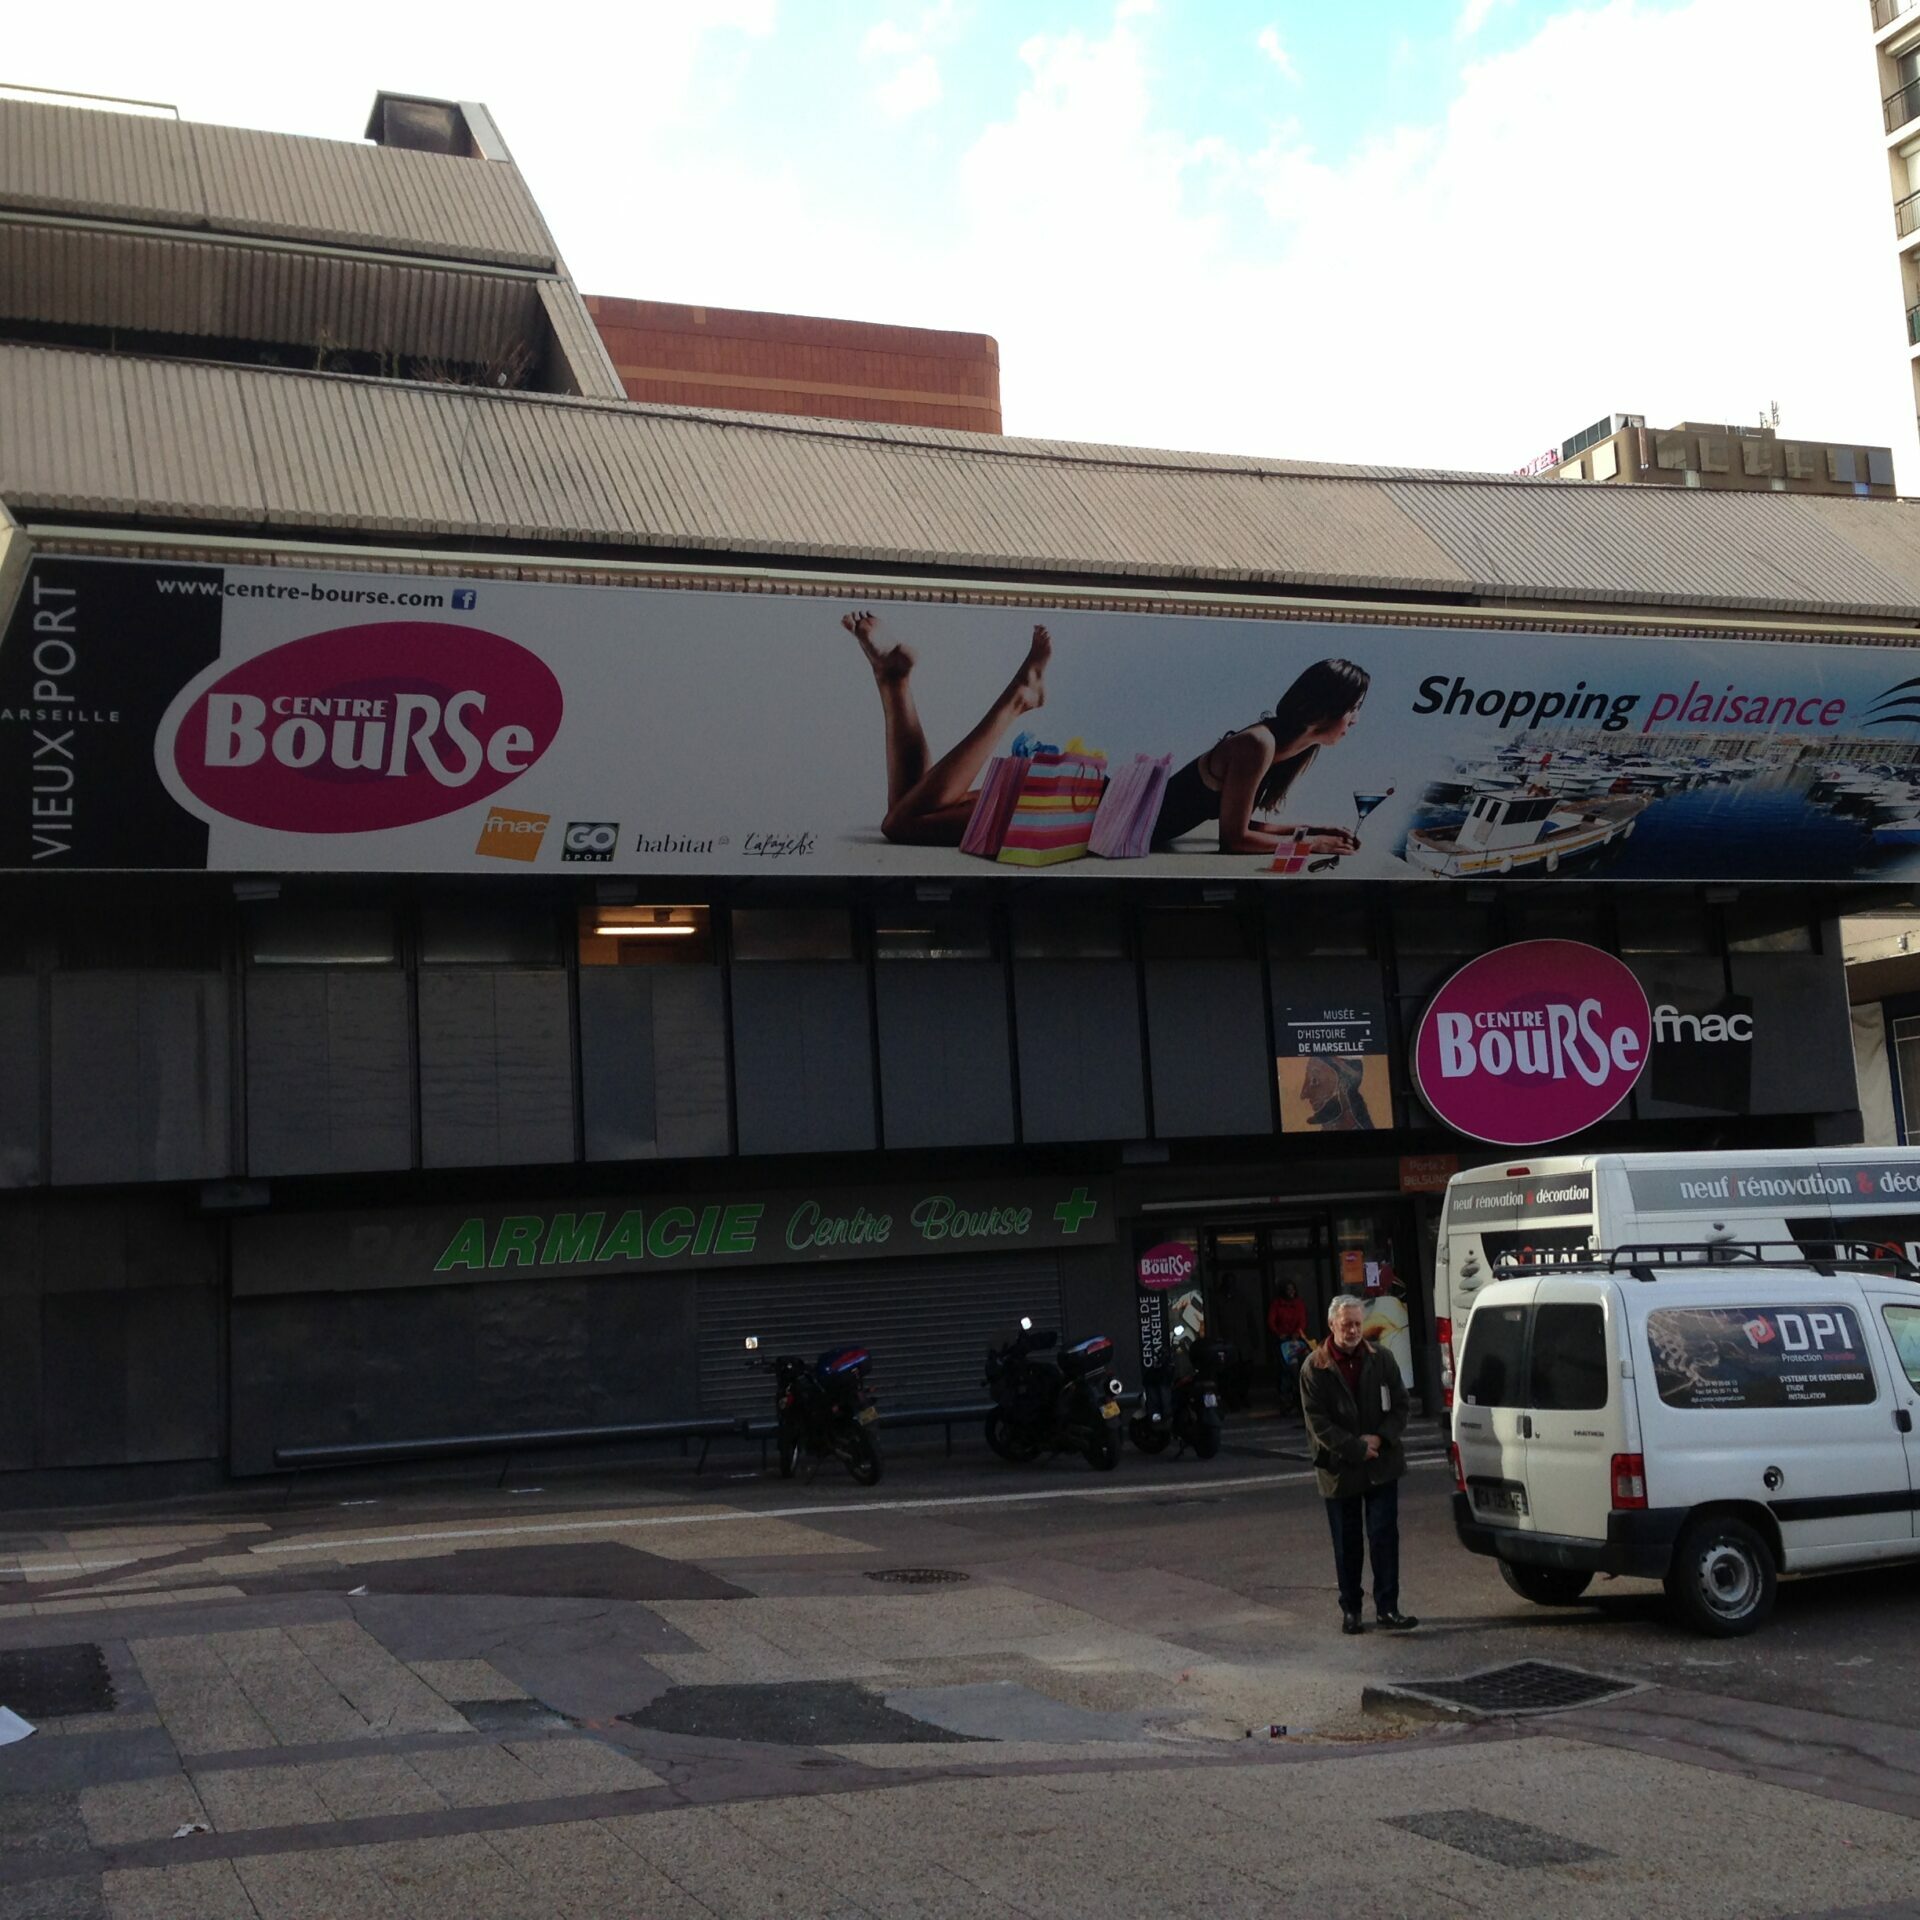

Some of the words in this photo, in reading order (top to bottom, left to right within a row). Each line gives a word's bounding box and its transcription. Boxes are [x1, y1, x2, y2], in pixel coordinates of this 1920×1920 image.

[155, 578, 444, 608] www.centre-bourse.com
[33, 576, 77, 701] PORT
[0, 708, 120, 723] ARSEILLE
[271, 695, 389, 718] CENTRE
[1411, 675, 1640, 732] Shopping
[1641, 681, 1846, 733] plaisance
[32, 729, 75, 860] VIEUX
[483, 815, 548, 834] fnac
[565, 823, 618, 850] GO
[636, 834, 714, 853] habitat
[564, 853, 612, 862] SPORT
[1323, 1008, 1356, 1020] MUSÉE
[1474, 1010, 1545, 1029] CENTRE
[1652, 1004, 1753, 1043] fnac
[1297, 1028, 1347, 1040] D'HISTOIRE
[1298, 1042, 1312, 1053] DE
[1313, 1041, 1366, 1053] MARSEILLE
[1403, 1174, 1451, 1186] BELSUNC
[1680, 1174, 1729, 1199] neuf
[1738, 1172, 1853, 1197] rénovation
[1856, 1171, 1874, 1194] &
[1879, 1170, 1920, 1193] déc
[1452, 1194, 1474, 1212] neuf
[1475, 1191, 1524, 1209] rénovation
[1536, 1184, 1590, 1204] décoration
[434, 1204, 765, 1271] ARMACIE
[785, 1200, 894, 1251] Centre
[909, 1195, 1031, 1240] Bourse
[1139, 1296, 1150, 1314] DE
[1141, 1316, 1153, 1368] CENTRE
[1150, 1295, 1162, 1368] ARSEILLE
[1775, 1312, 1853, 1351] DPI
[1781, 1352, 1823, 1364] Protection
